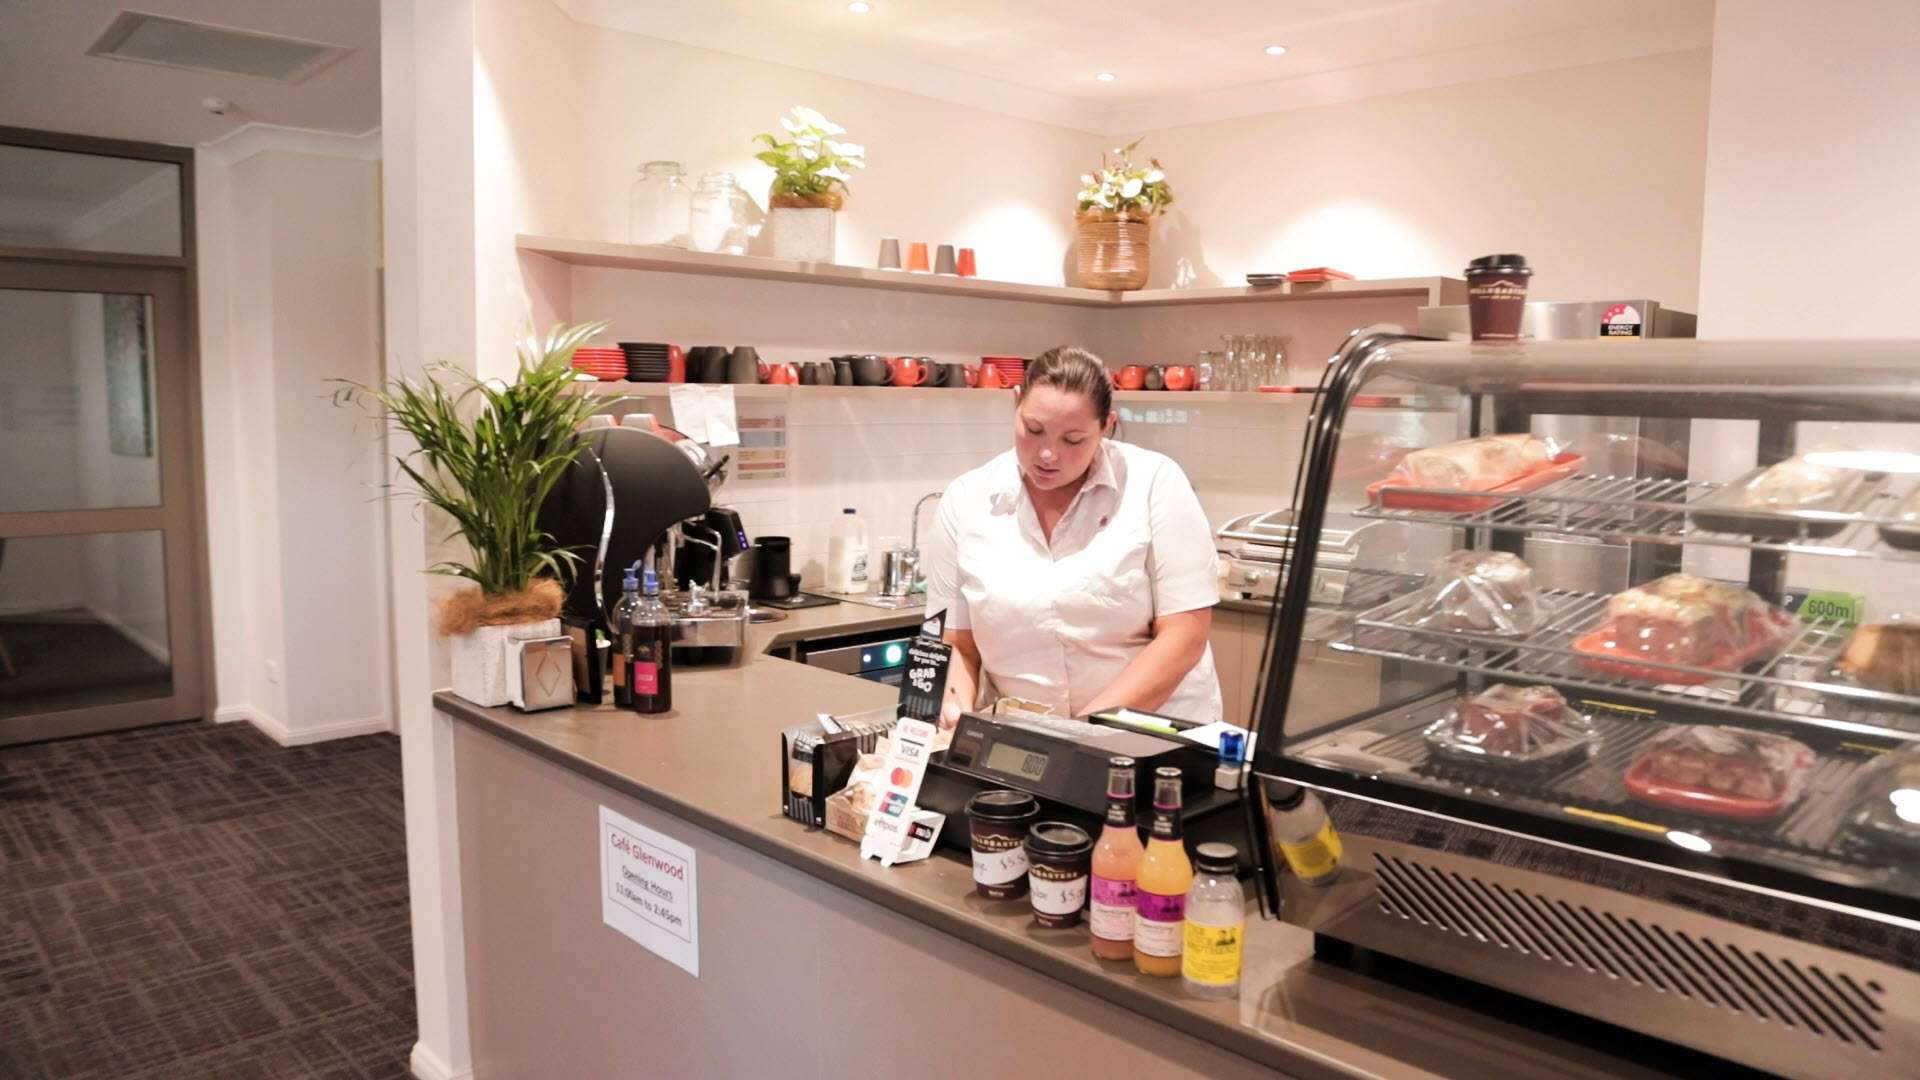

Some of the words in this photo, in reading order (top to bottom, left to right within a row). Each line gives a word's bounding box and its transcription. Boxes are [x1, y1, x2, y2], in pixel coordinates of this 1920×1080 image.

[1808, 599, 1850, 618] 600m
[909, 667, 936, 680] GRAB
[901, 744, 920, 757] VISA
[611, 834, 631, 854] Café
[632, 845, 684, 880] Glenwood
[622, 865, 649, 889] Opening
[650, 881, 673, 900] Hours
[644, 899, 653, 911] to
